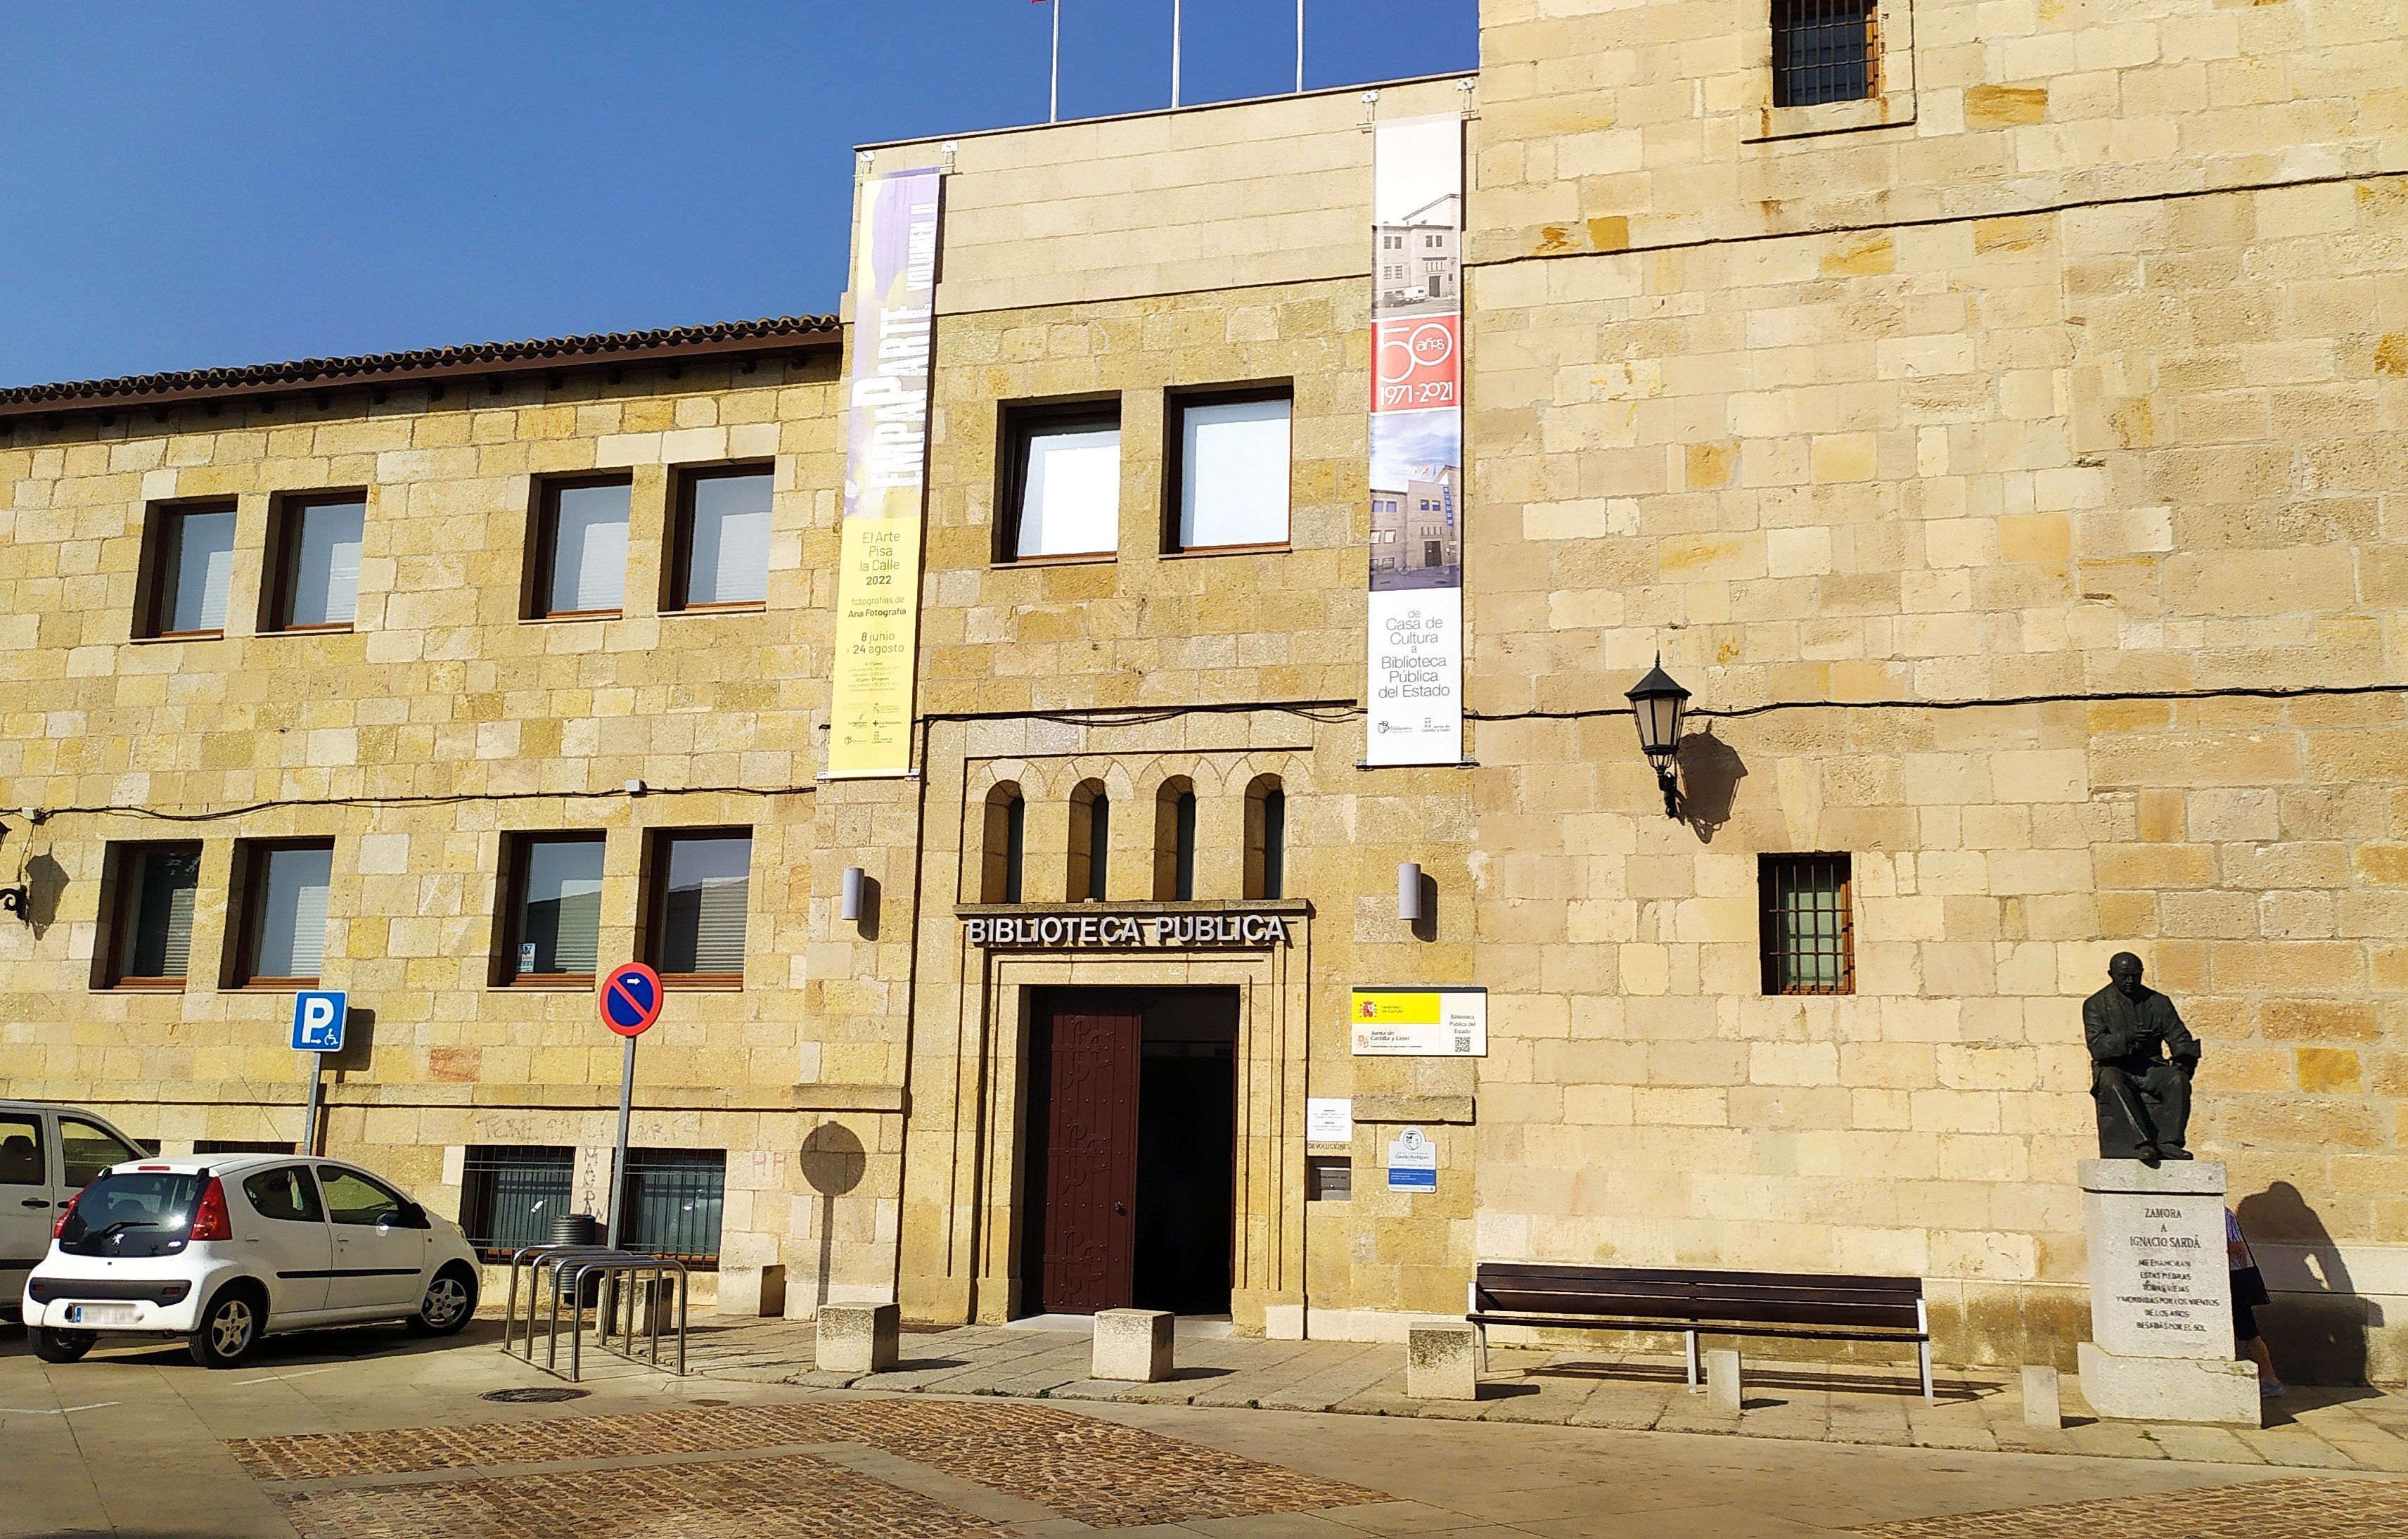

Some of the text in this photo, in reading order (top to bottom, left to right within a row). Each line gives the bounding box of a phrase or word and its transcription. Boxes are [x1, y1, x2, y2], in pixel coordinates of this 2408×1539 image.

[907, 221, 936, 292] VOLUMEN
[1416, 338, 1446, 352] años
[1378, 323, 1453, 383] 50
[1380, 381, 1454, 406] 1971-2021
[863, 531, 901, 544] El Arte
[869, 545, 893, 557] Pisa
[859, 558, 900, 572] la Calle
[866, 575, 892, 586] 2022
[847, 610, 864, 618] Ana
[1407, 609, 1421, 618] de
[1385, 616, 1443, 631] Casa de
[861, 630, 895, 644] 8 junio
[1390, 632, 1439, 645] Cultura
[852, 643, 904, 656] 24 agosto
[1381, 655, 1447, 670] Biblioteca
[1389, 669, 1439, 683] Pública
[1378, 683, 1450, 698] del Estado
[968, 914, 1286, 943] BIBLIOTECA PUBLICA
[302, 997, 334, 1044] P
[2144, 1208, 2182, 1219] ZAMORA
[2160, 1223, 2168, 1232] A
[2130, 1236, 2168, 1247] IGNACIO
[2139, 1271, 2191, 1281] ESTAS PIEDRAS
[2144, 1308, 2153, 1317] DE
[2183, 1323, 2193, 1332] EL
[2193, 1324, 2208, 1332] SOL
